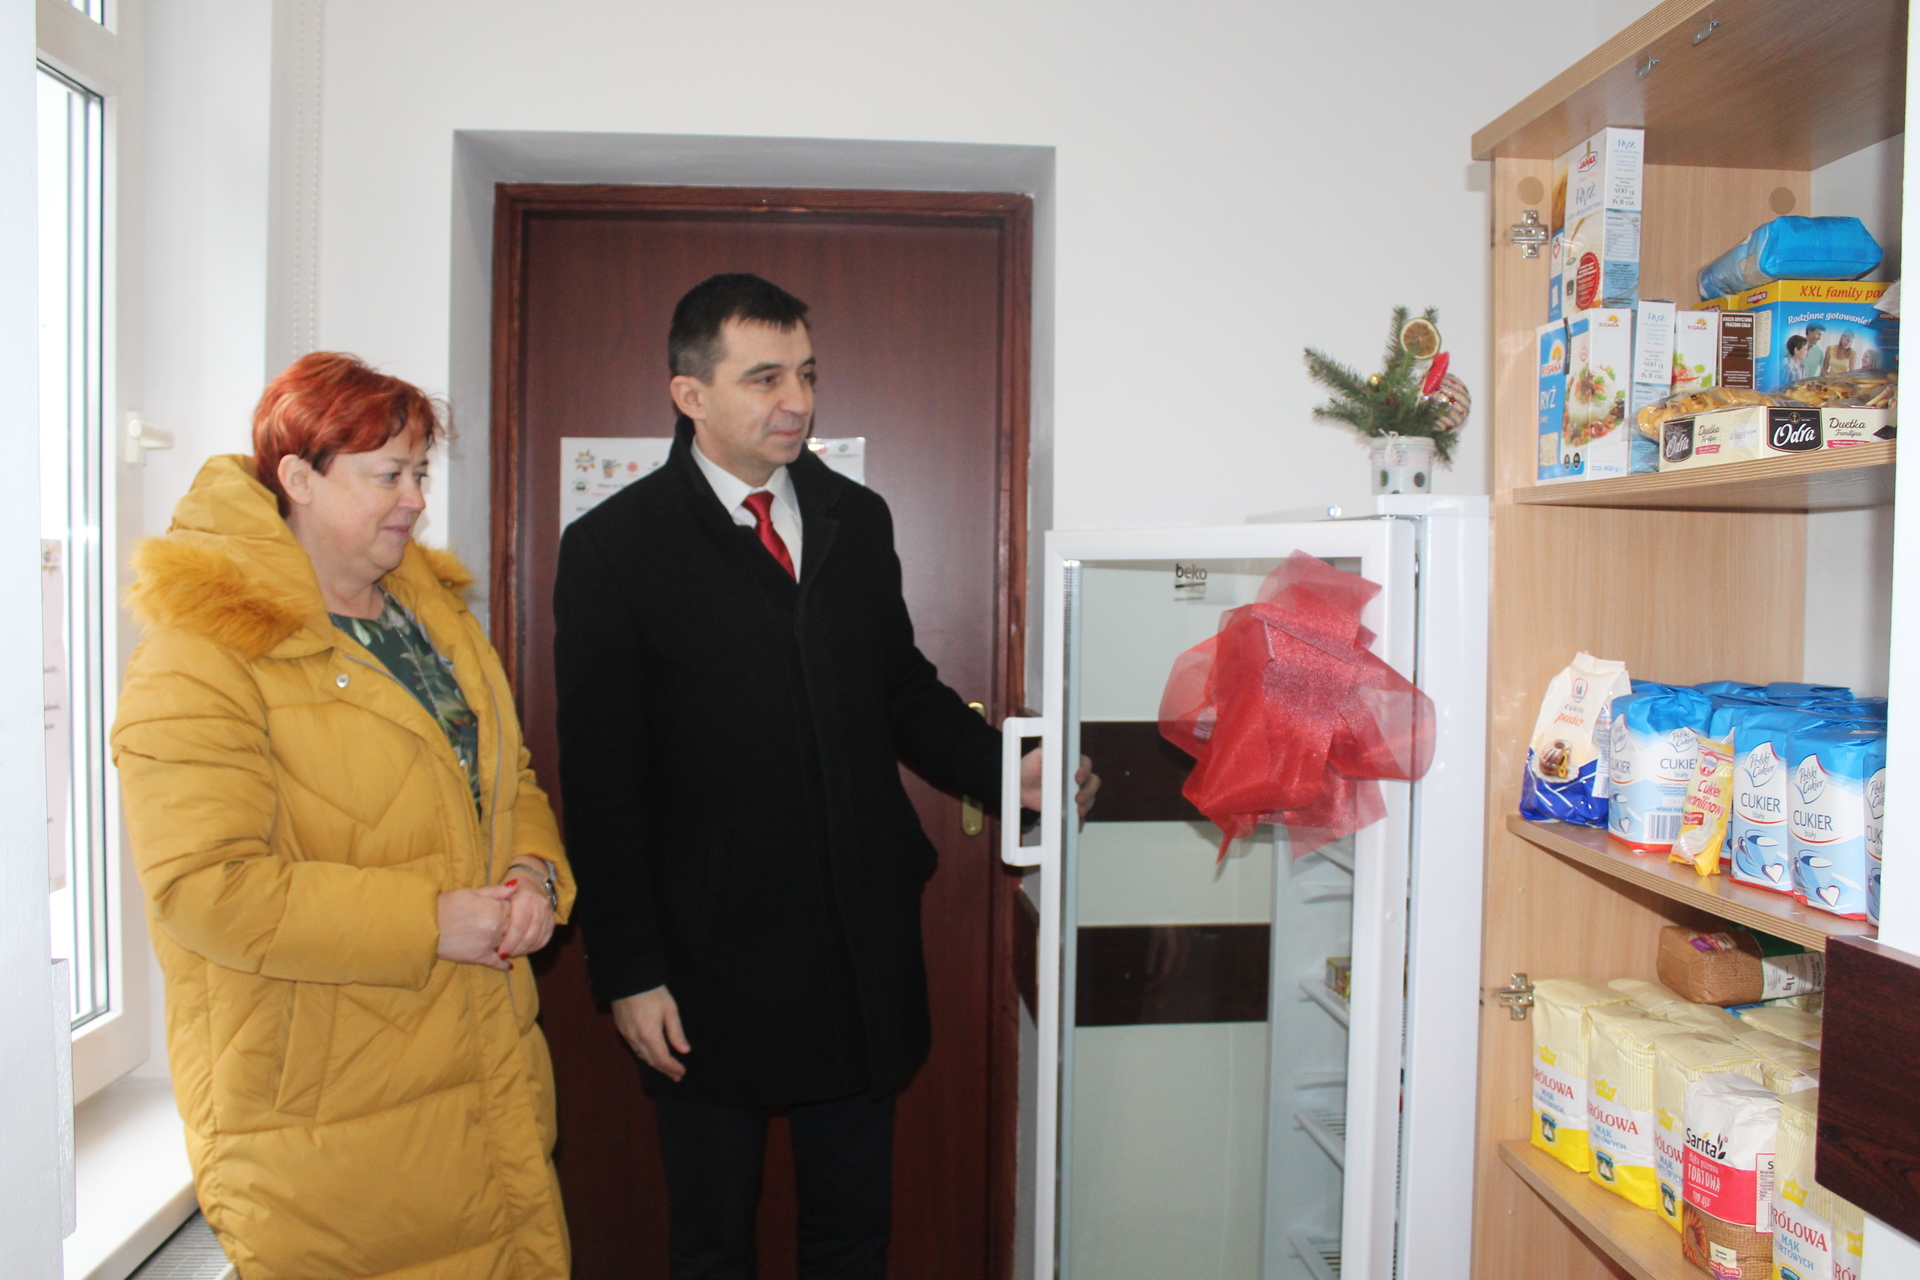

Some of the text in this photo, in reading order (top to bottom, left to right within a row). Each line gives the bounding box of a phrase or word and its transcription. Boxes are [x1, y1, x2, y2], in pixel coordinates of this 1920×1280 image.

[1799, 285, 1823, 297] XXL
[1826, 287, 1862, 300] family
[1788, 312, 1824, 325] Rodzinne
[1826, 312, 1872, 325] gotowanie!
[1540, 385, 1557, 411] RYŻ
[1829, 417, 1867, 429] Duetka
[1773, 423, 1816, 446] Odra
[1665, 434, 1690, 458] Odra
[1176, 563, 1207, 580] beko
[1660, 758, 1698, 770] CUKIE
[1749, 752, 1771, 769] Polski
[1753, 764, 1775, 778] Cukier
[1800, 765, 1818, 784] Polski
[1697, 780, 1721, 798] Cukier
[1803, 780, 1824, 794] Cukier
[1741, 792, 1781, 813] CUKIER
[1793, 810, 1833, 831] CUKIER
[1685, 1127, 1717, 1158] Sarita
[1688, 1164, 1720, 1192] TORTOWA
[1701, 1195, 1711, 1208] 450
[1773, 1208, 1828, 1252] RÓLOWA
[1781, 1234, 1800, 1252] MĄK
